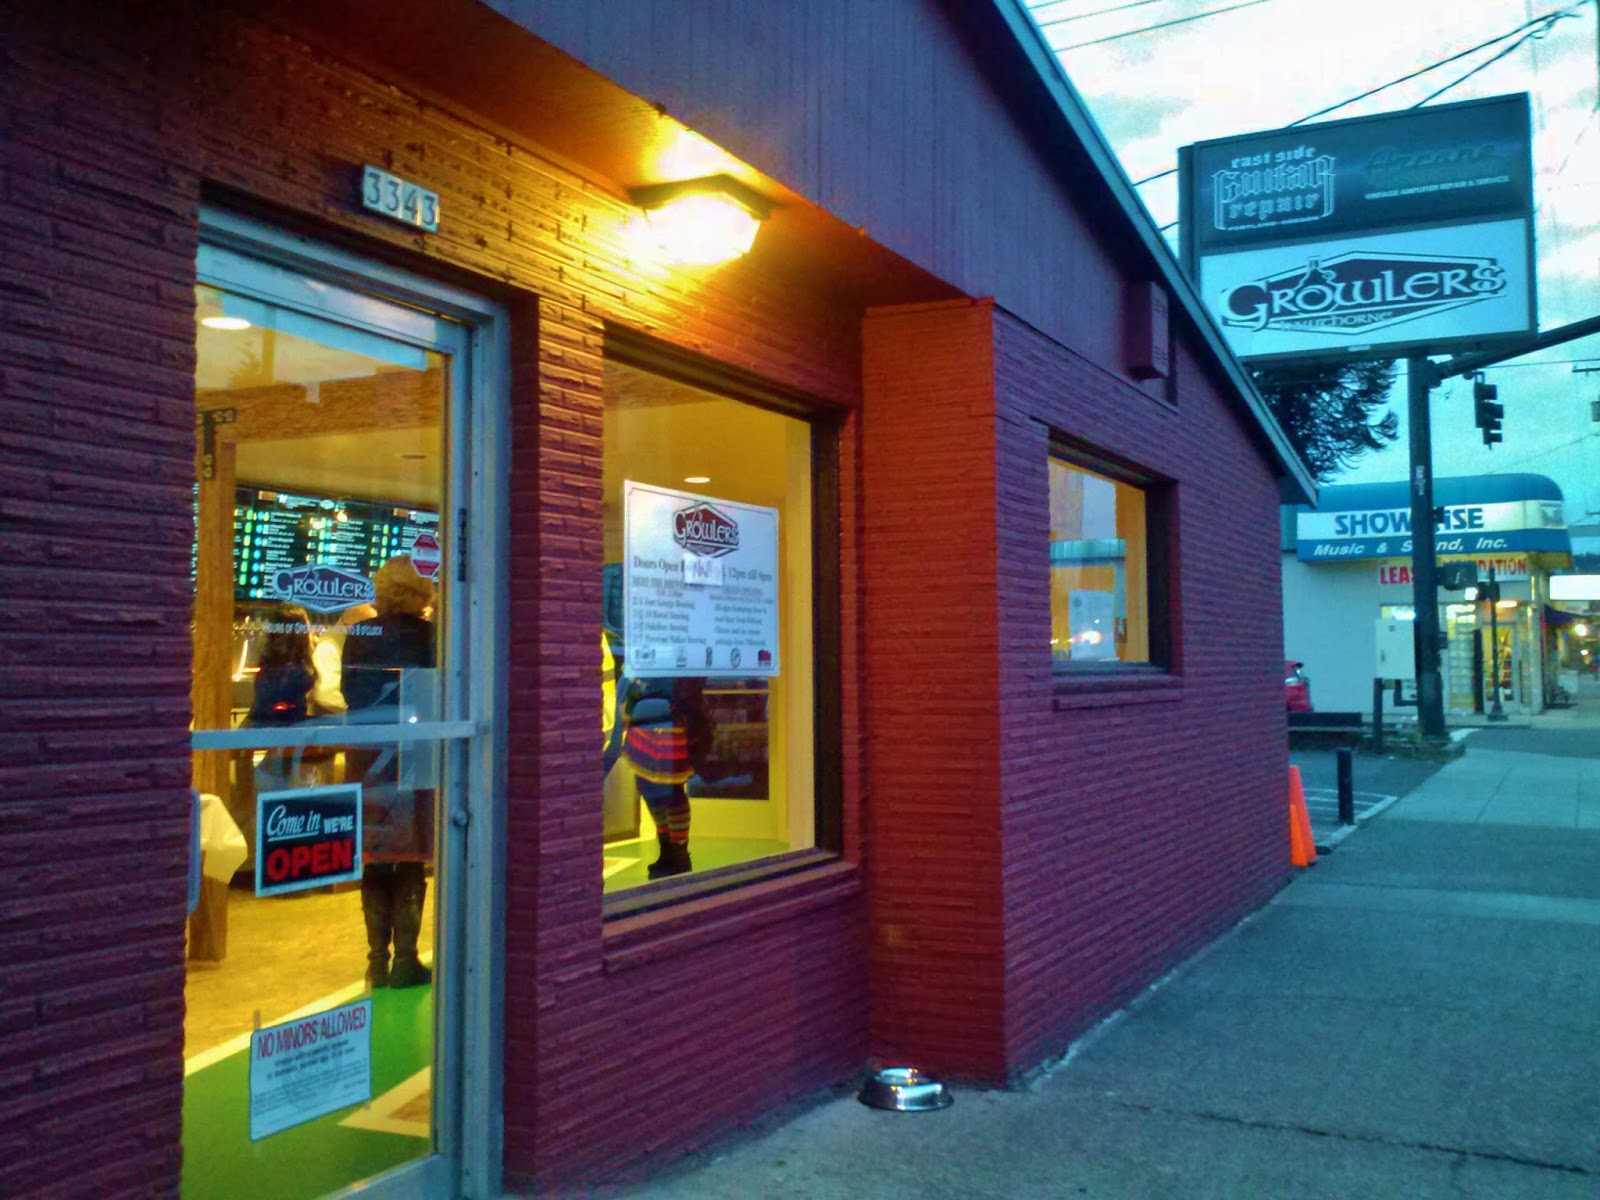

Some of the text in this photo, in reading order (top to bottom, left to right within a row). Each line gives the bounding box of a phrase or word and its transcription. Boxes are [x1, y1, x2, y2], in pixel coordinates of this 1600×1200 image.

[366, 171, 436, 226] 3343
[1314, 543, 1365, 556] Music
[1376, 542, 1388, 553] &
[1476, 537, 1508, 549] Inc.
[266, 804, 306, 836] Come
[306, 809, 321, 833] in
[266, 838, 353, 881] OPEN
[257, 1031, 275, 1061] NO
[277, 1019, 319, 1054] MINORS
[320, 1005, 367, 1040] ALLOWED
